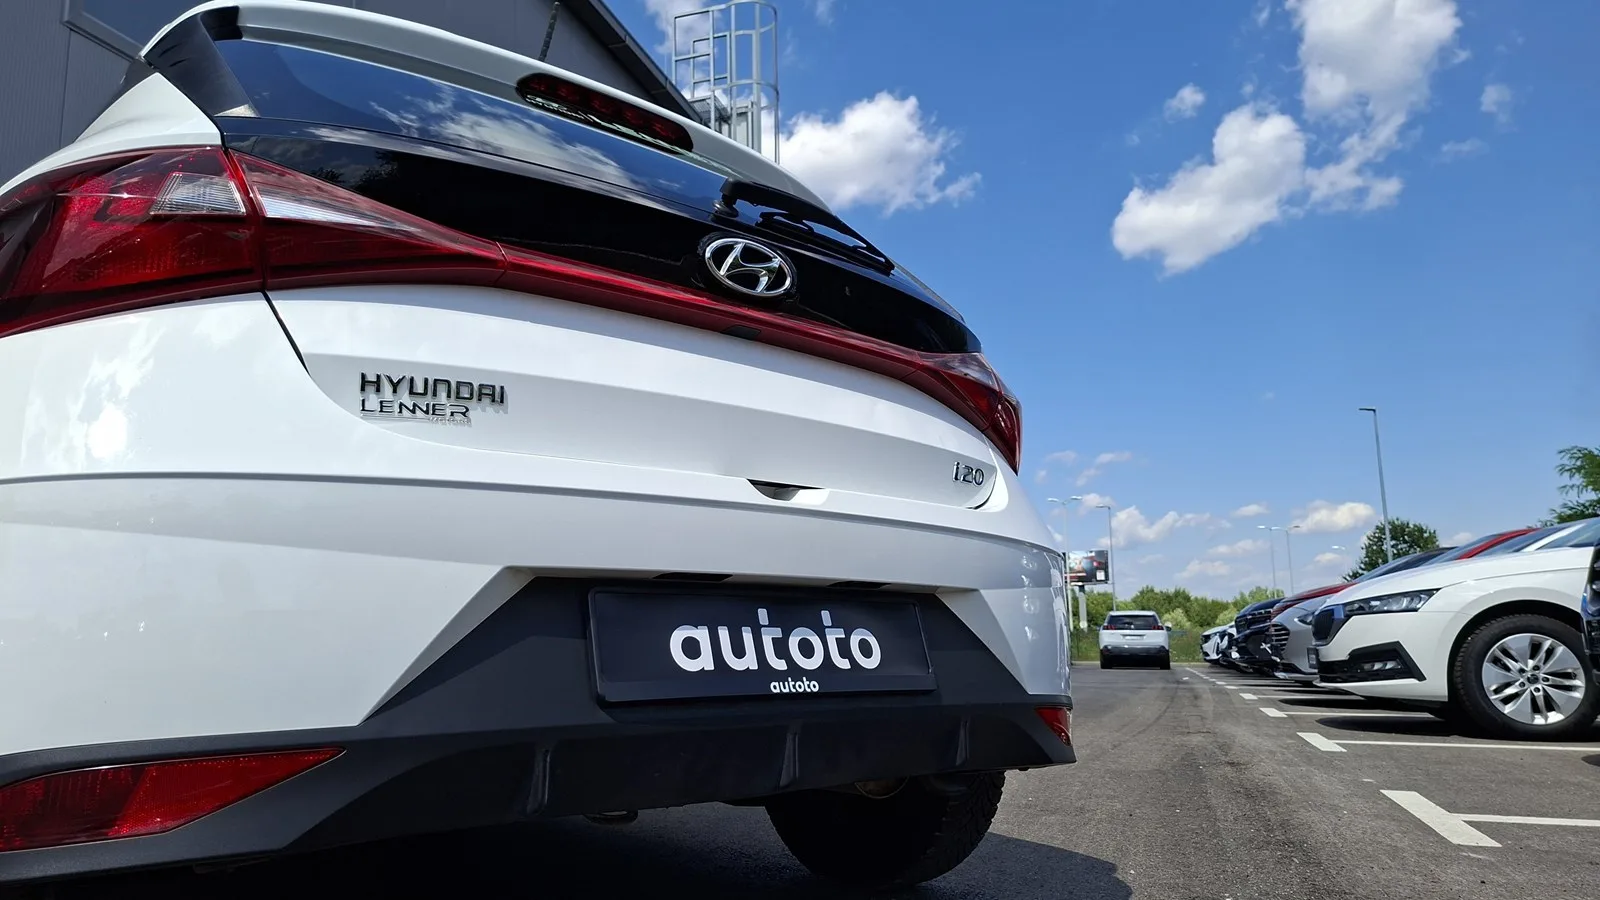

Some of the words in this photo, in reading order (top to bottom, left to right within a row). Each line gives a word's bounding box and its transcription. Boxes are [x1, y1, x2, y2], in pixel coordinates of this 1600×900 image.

[360, 372, 505, 404] HYUNDAI
[360, 398, 470, 417] LENNER
[953, 461, 985, 486] i20
[670, 608, 882, 672] autoto
[770, 676, 820, 694] autoto
